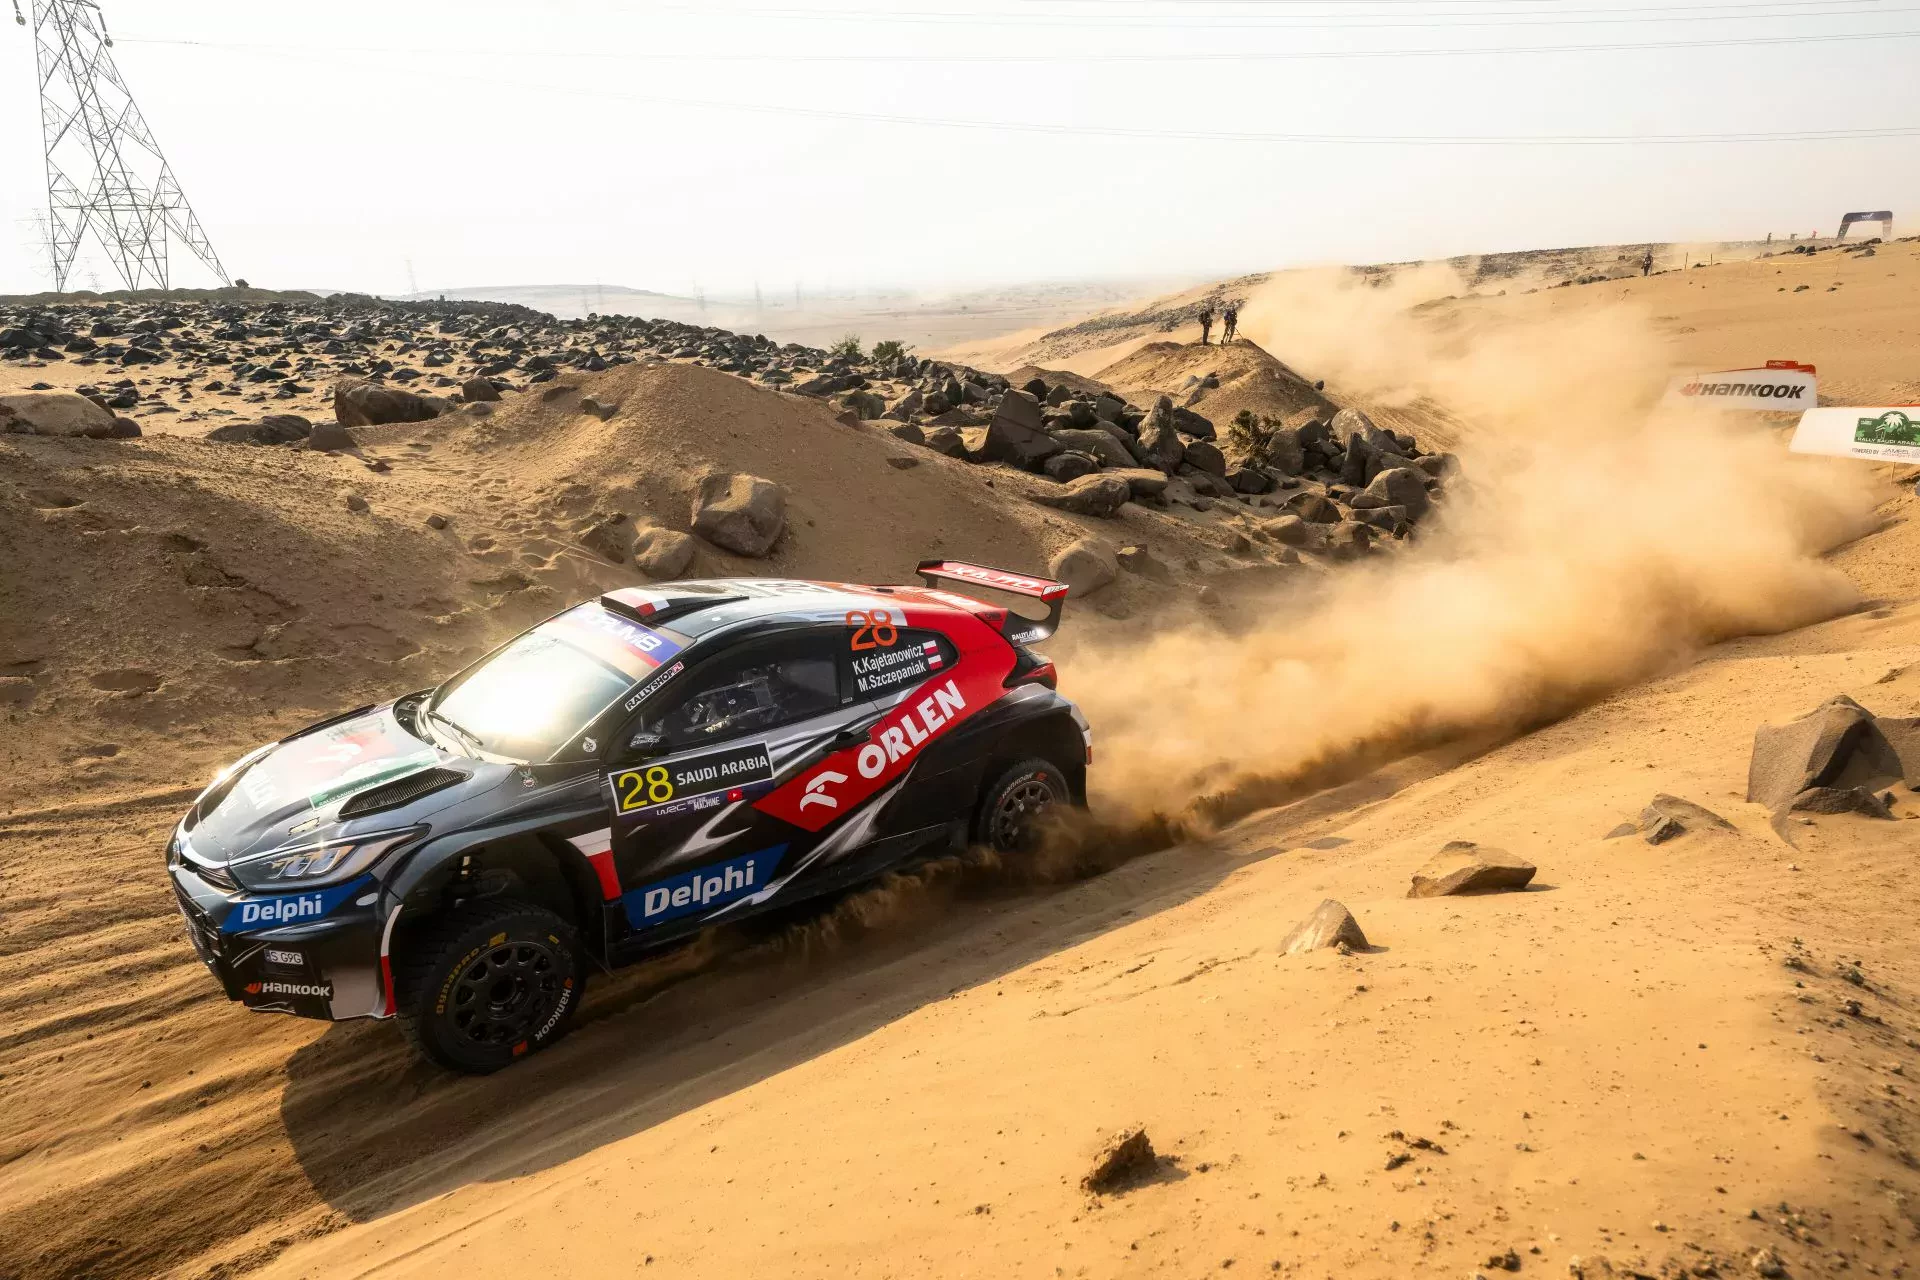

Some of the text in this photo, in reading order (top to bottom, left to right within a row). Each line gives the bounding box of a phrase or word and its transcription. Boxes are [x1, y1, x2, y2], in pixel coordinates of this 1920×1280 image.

[951, 567, 1040, 588] KAJTO
[845, 609, 898, 651] 28
[852, 645, 924, 676] K.Kajetanowicz
[857, 660, 927, 693] M.Szczepaniak
[857, 679, 967, 779] ORLEN
[618, 755, 769, 811] 28 SAUDI ARABIA
[693, 796, 720, 812] MACHINE
[644, 859, 755, 918] Delphi
[242, 894, 322, 923] Delphi
